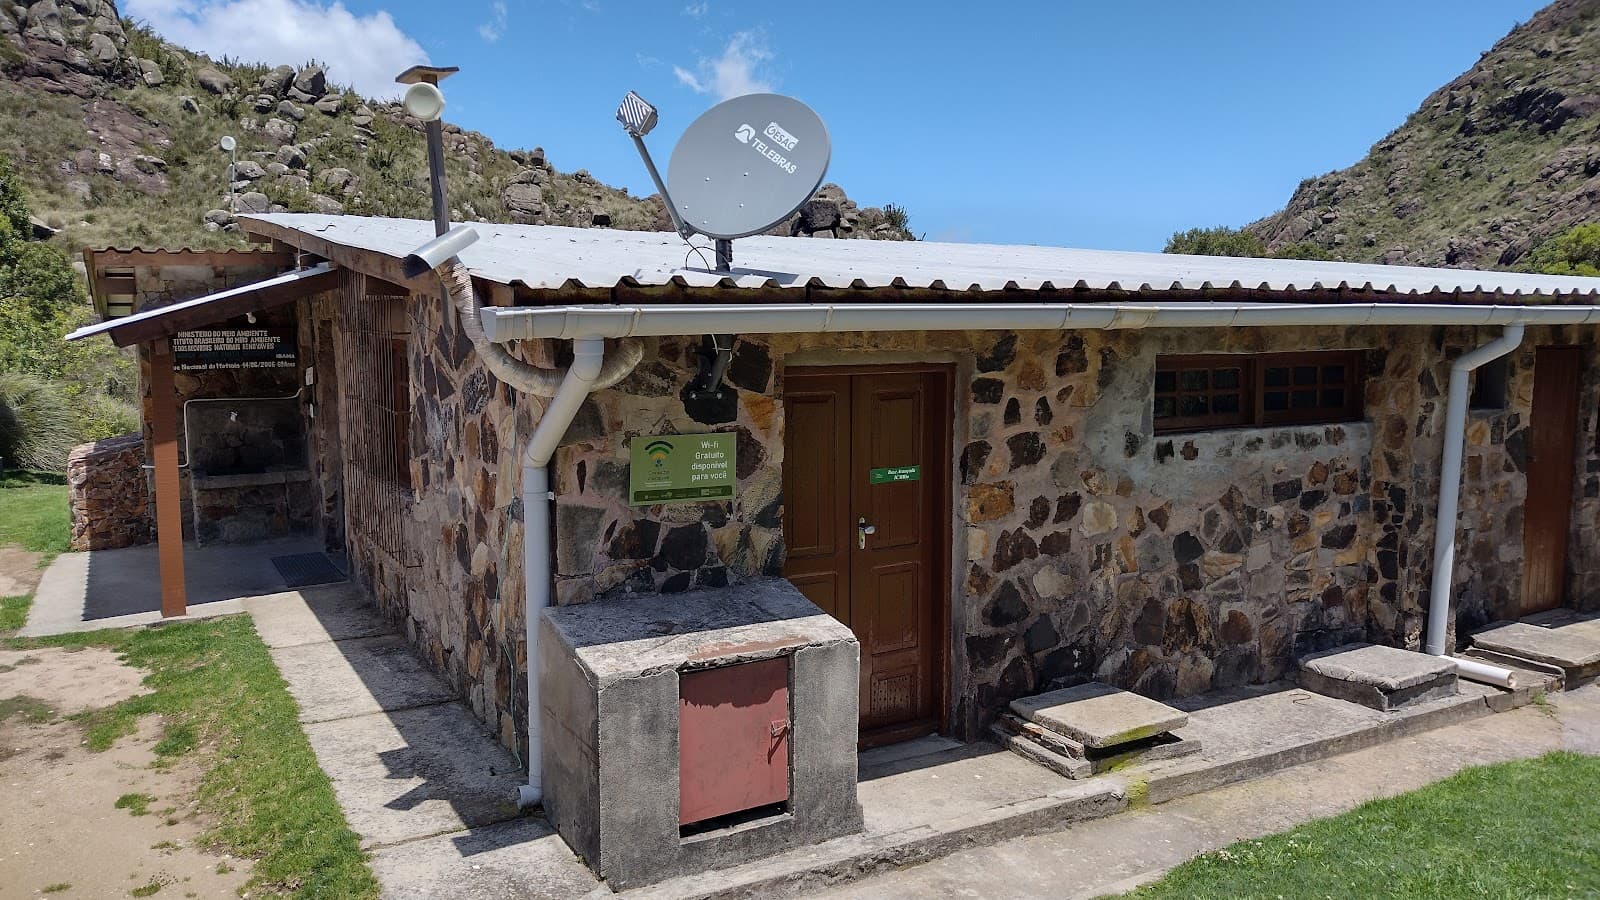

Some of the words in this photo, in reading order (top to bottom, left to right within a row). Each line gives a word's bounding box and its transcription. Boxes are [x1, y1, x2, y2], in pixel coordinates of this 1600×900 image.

[766, 126, 795, 150] GESAC
[752, 138, 796, 174] TELEBRAS
[691, 461, 727, 471] disponível
[692, 474, 708, 483] para
[711, 471, 727, 479] você
